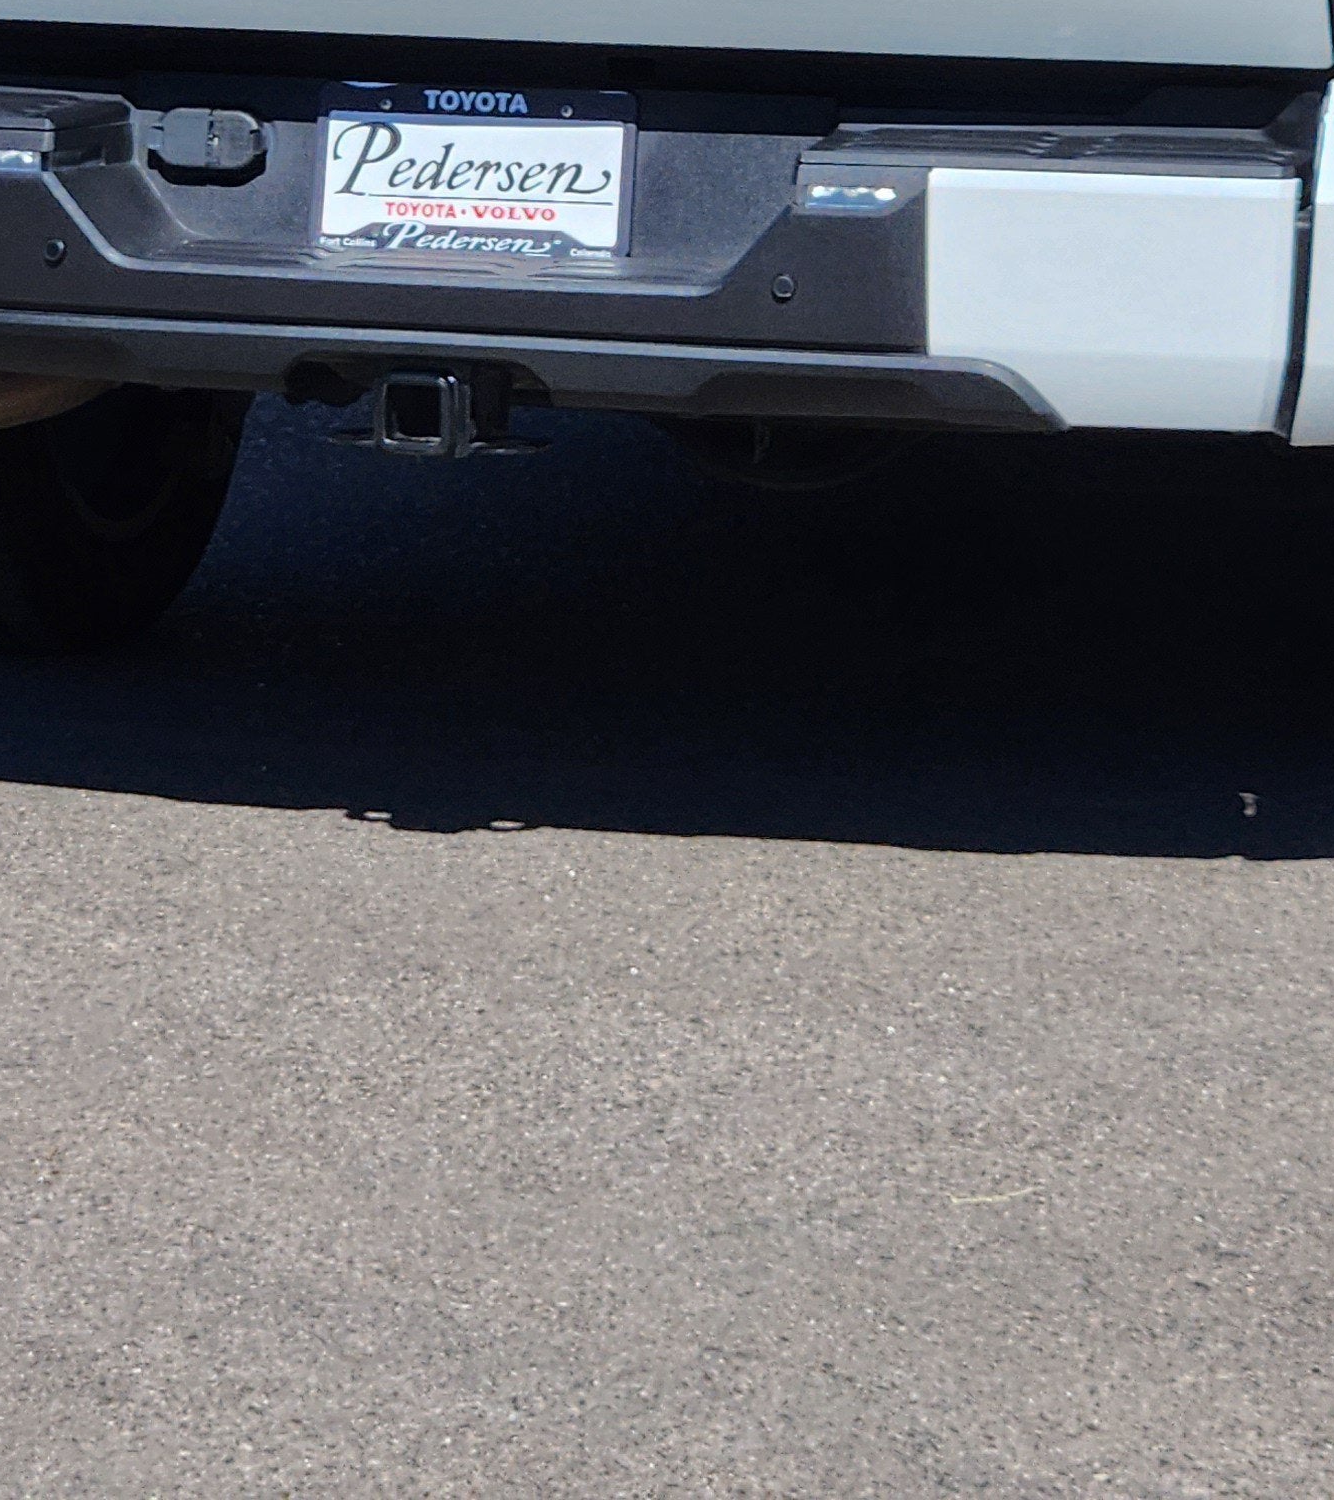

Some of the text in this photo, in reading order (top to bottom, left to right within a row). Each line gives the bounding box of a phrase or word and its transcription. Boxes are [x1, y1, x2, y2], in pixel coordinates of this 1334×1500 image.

[423, 88, 529, 115] TOYOTA
[333, 120, 613, 197] Pedersen
[385, 201, 556, 222] TOYOTA VOLVO
[382, 219, 551, 255] Pedersen
